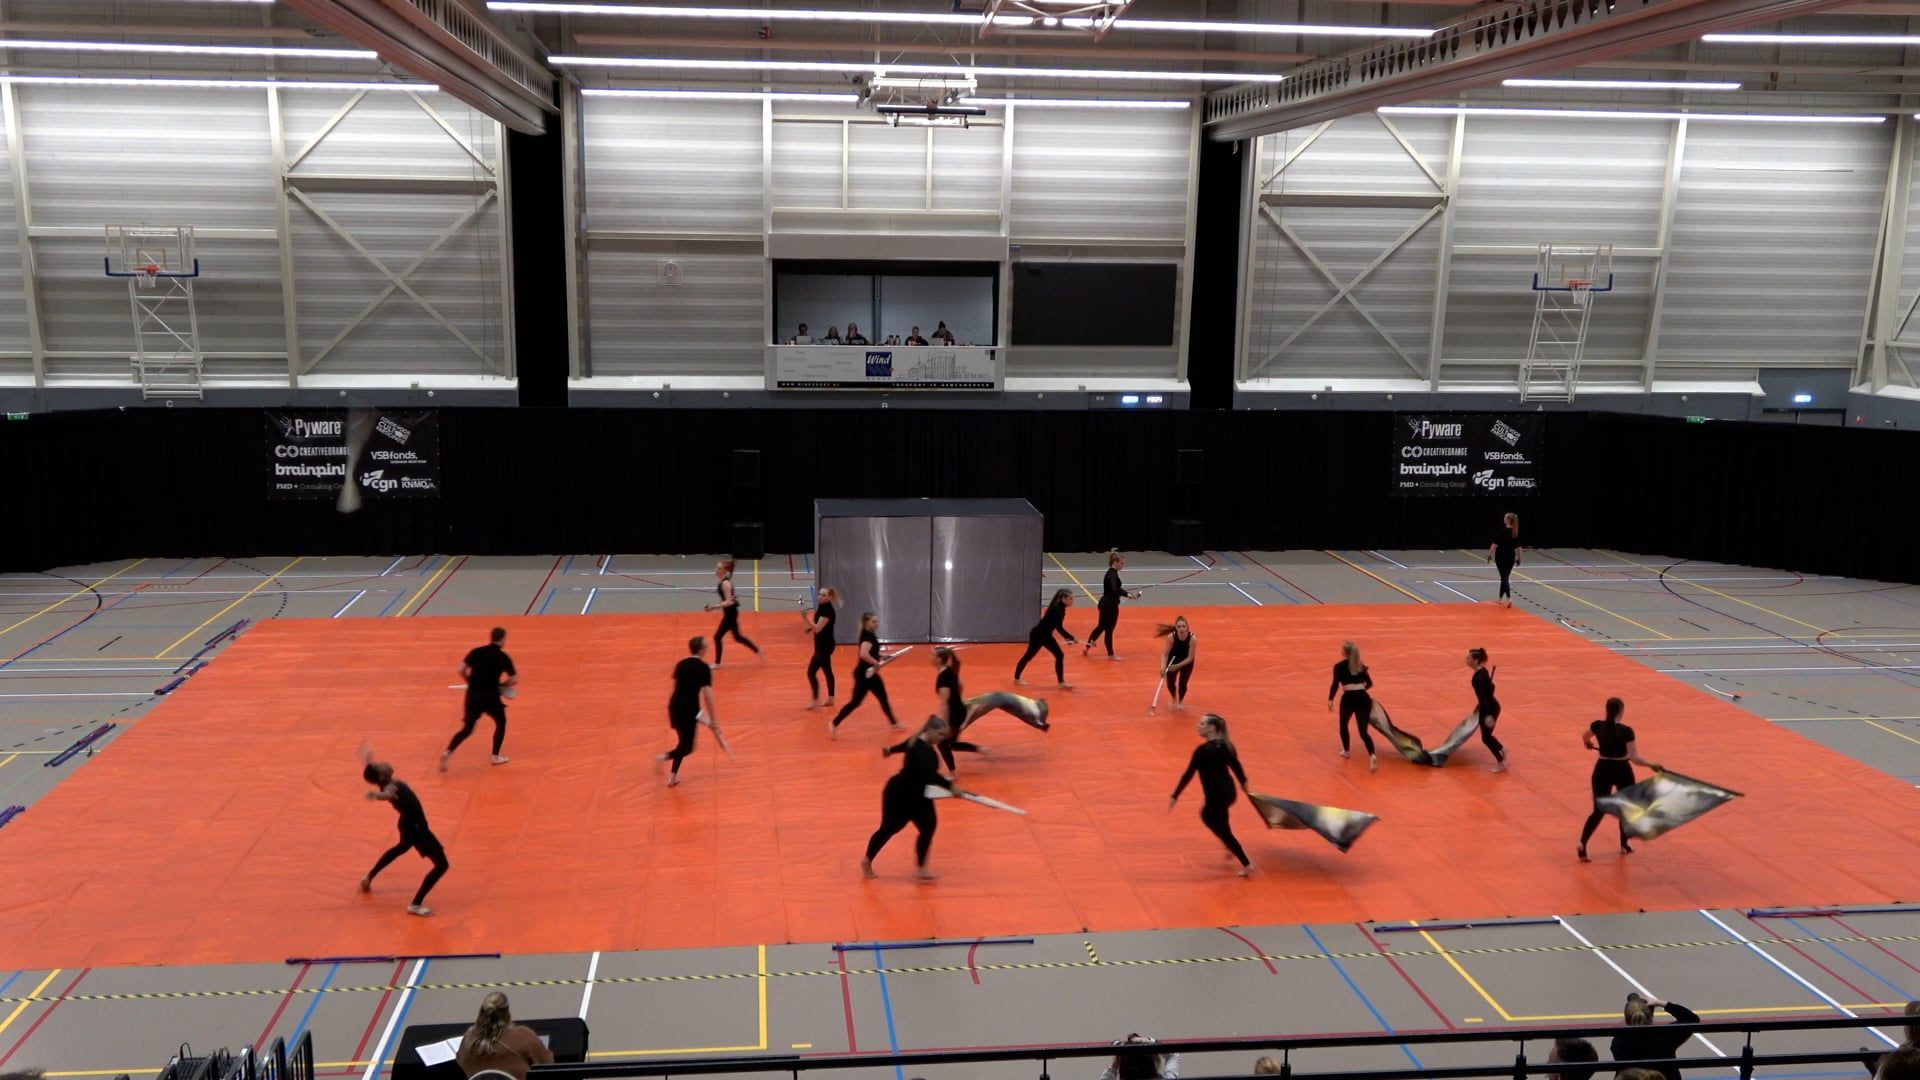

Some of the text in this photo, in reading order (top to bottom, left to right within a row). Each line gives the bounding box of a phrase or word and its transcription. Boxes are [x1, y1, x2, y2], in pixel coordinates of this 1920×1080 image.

[295, 419, 341, 438] Pyware
[1422, 421, 1462, 439] Pyware
[1400, 463, 1468, 477] brainpink
[371, 480, 398, 493] cgn
[1482, 479, 1504, 491] cgn
